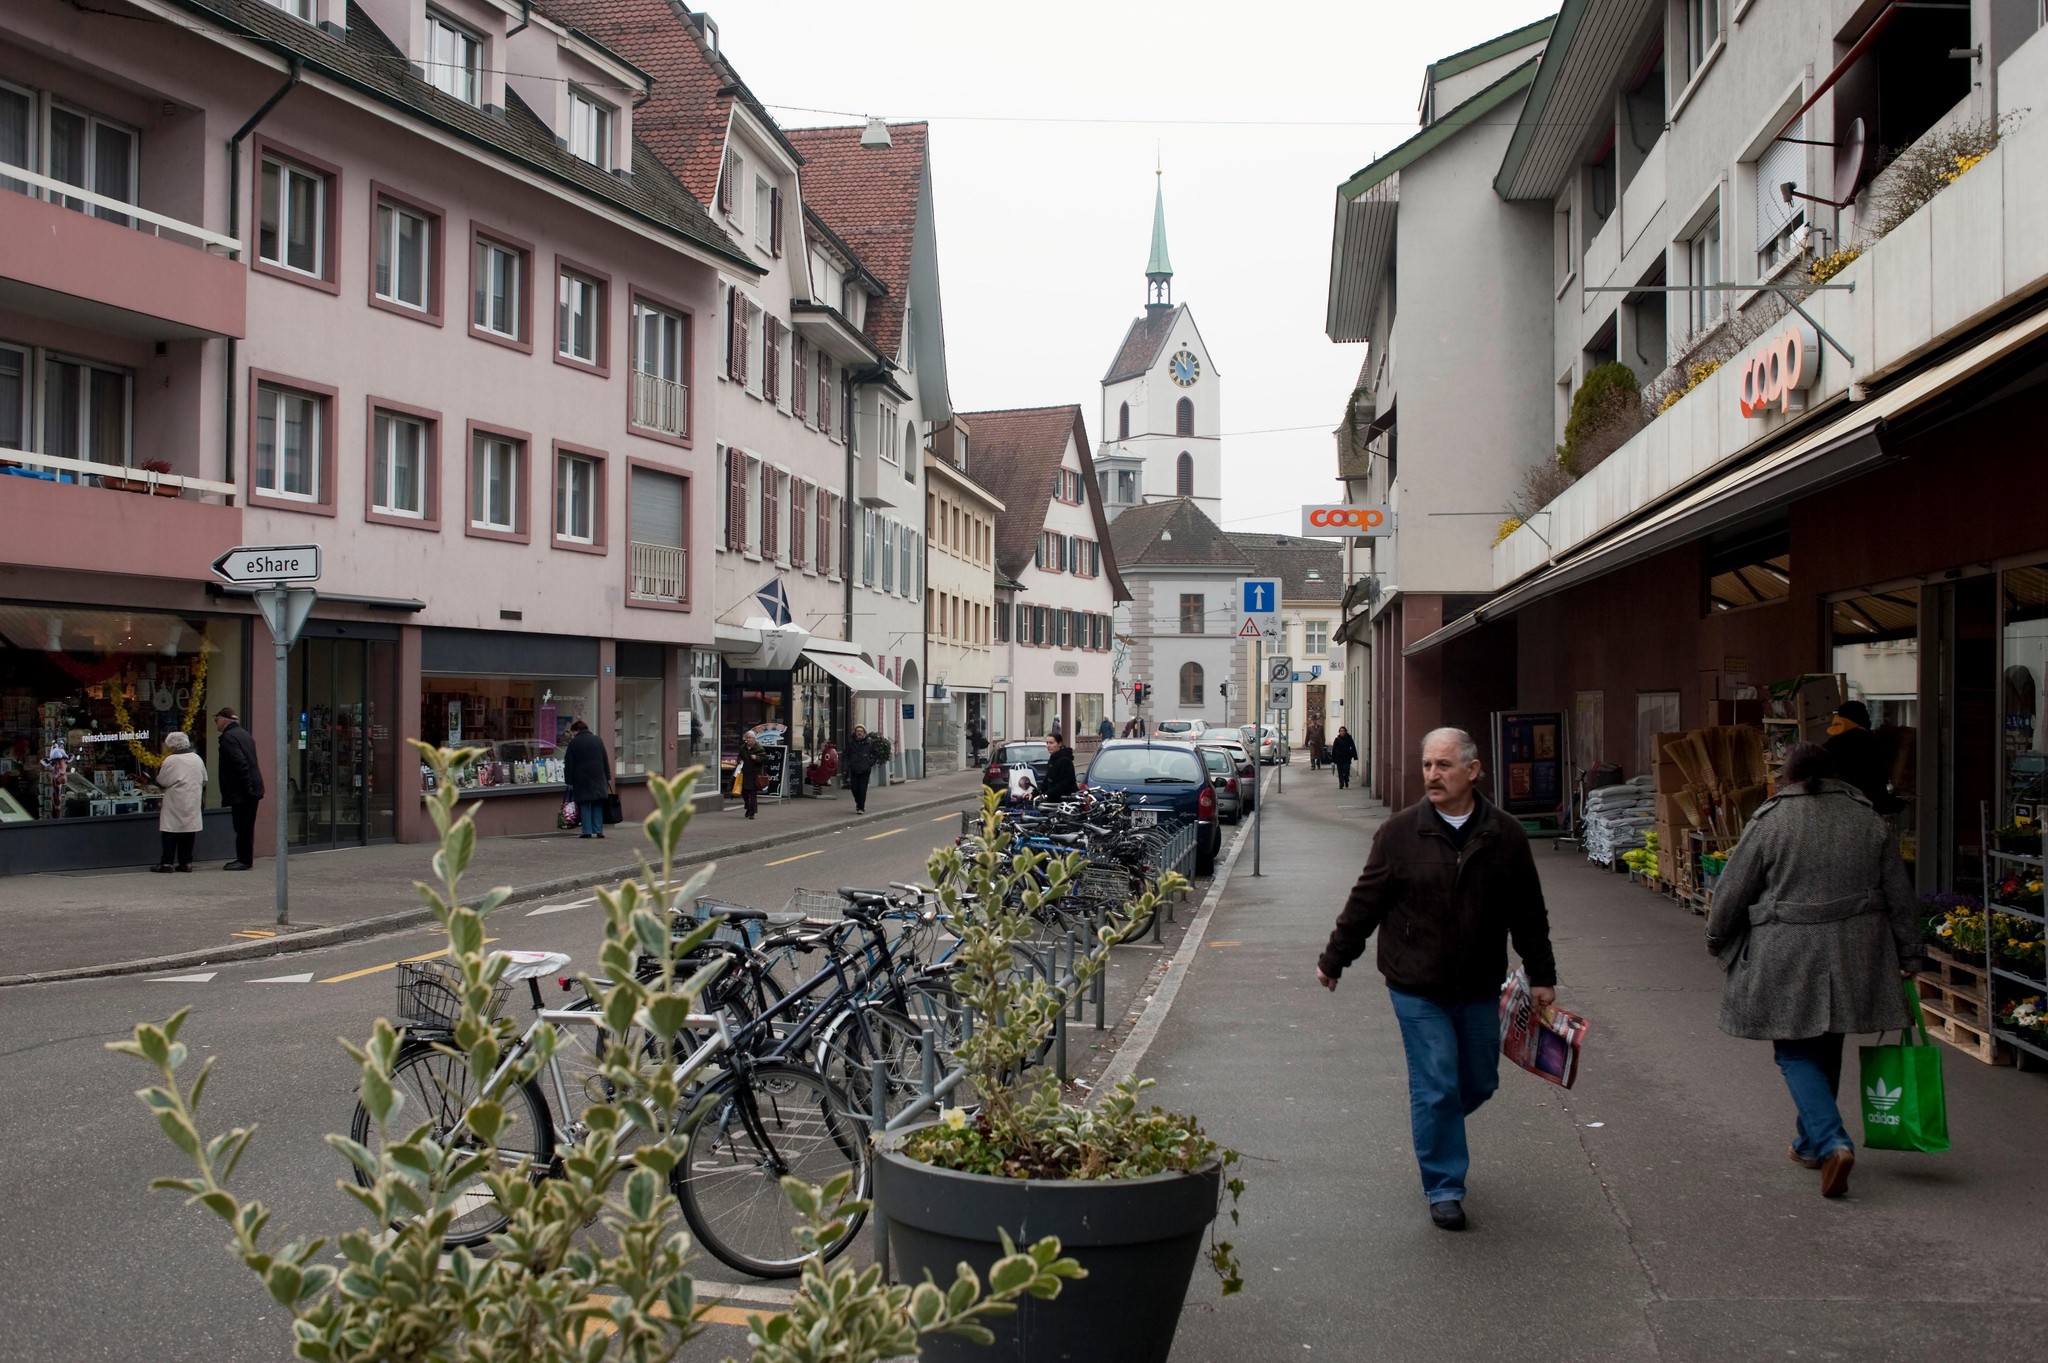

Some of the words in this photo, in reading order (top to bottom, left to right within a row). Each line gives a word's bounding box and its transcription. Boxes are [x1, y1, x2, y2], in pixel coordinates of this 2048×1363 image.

[1740, 325, 1803, 419] coop
[1310, 509, 1384, 532] coop
[246, 556, 299, 573] eShare
[82, 732, 118, 743] reinschauen
[119, 731, 135, 742] lohnt
[135, 730, 150, 740] sich!
[1867, 1111, 1901, 1126] adidas
